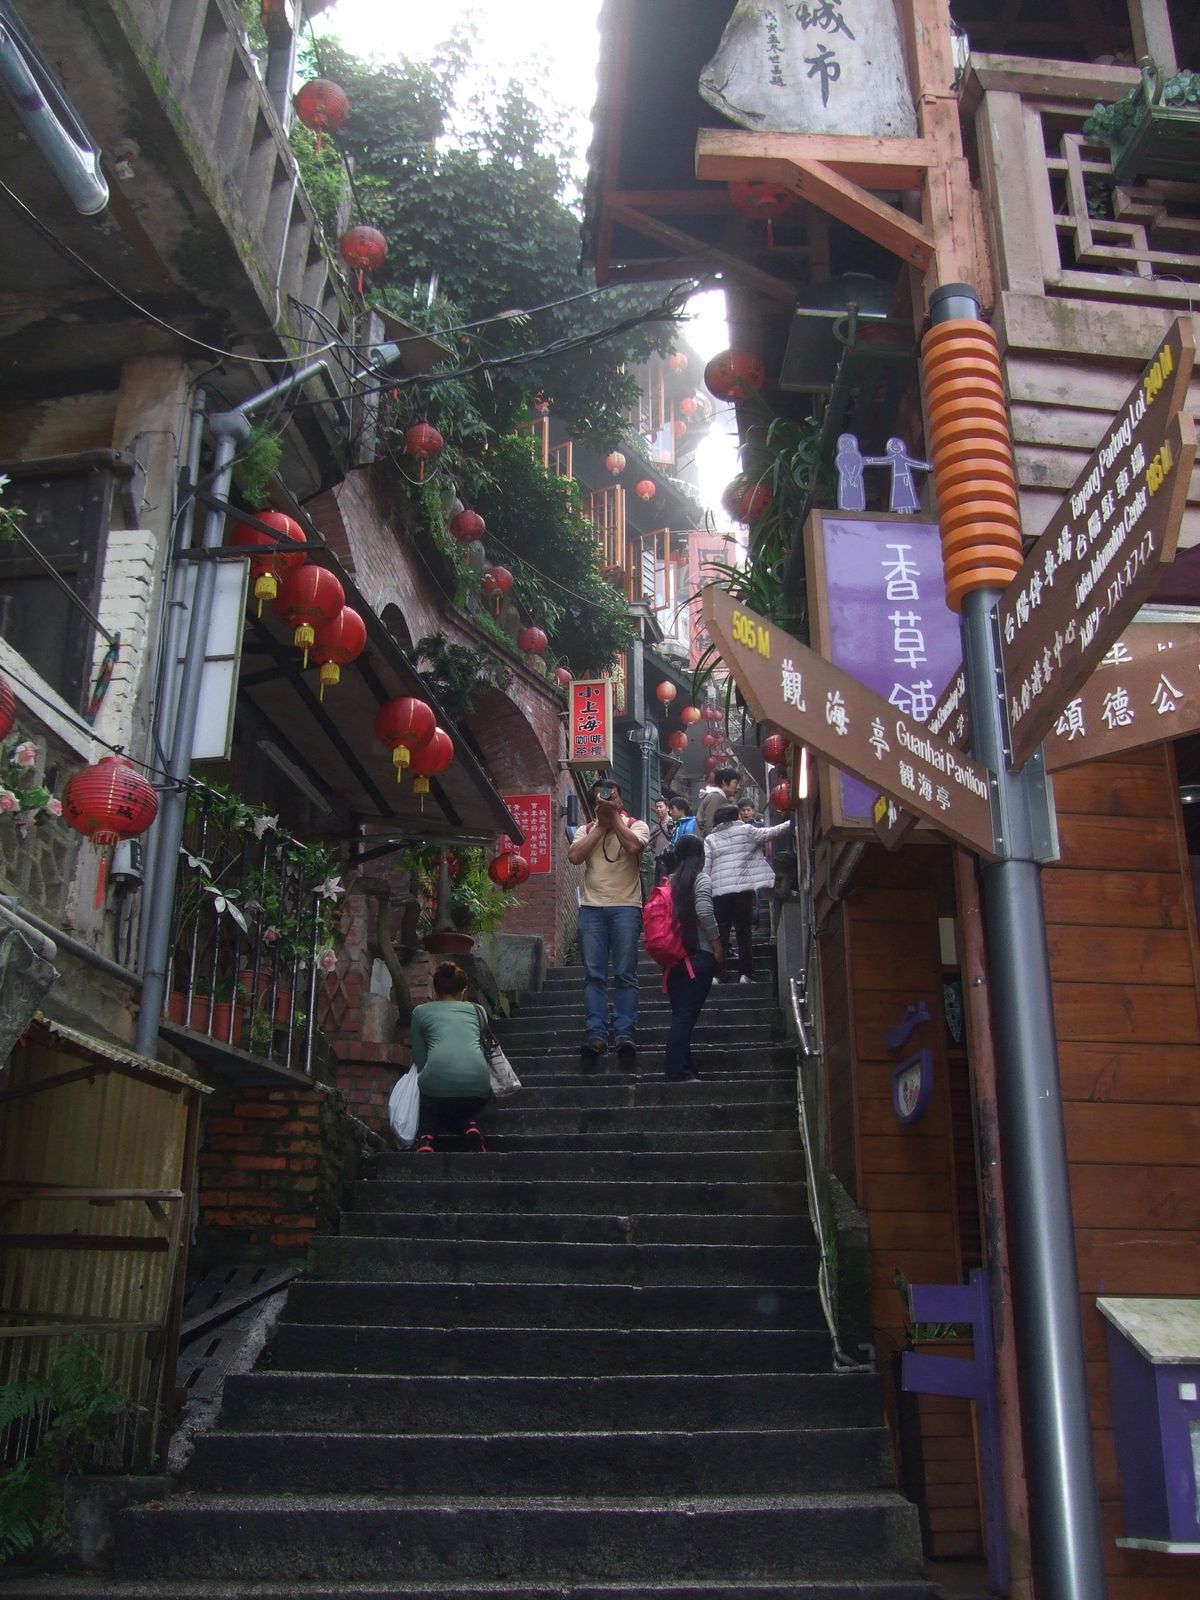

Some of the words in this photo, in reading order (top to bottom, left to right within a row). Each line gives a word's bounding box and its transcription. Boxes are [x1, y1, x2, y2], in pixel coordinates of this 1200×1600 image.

[1069, 466, 1101, 520] Taiyang
[1099, 418, 1132, 477] Parking
[1129, 390, 1147, 429] Lot
[1159, 344, 1173, 380] M
[1091, 521, 1127, 584] Information
[1124, 486, 1148, 533] Center
[1160, 439, 1174, 475] M
[732, 611, 757, 651] 505
[757, 634, 771, 659] M
[577, 686, 601, 732] 小上海
[781, 659, 891, 760] 觀海亭
[1053, 664, 1200, 741] 頌德公
[896, 720, 945, 772] Guanhai
[945, 761, 989, 800] Pavilion
